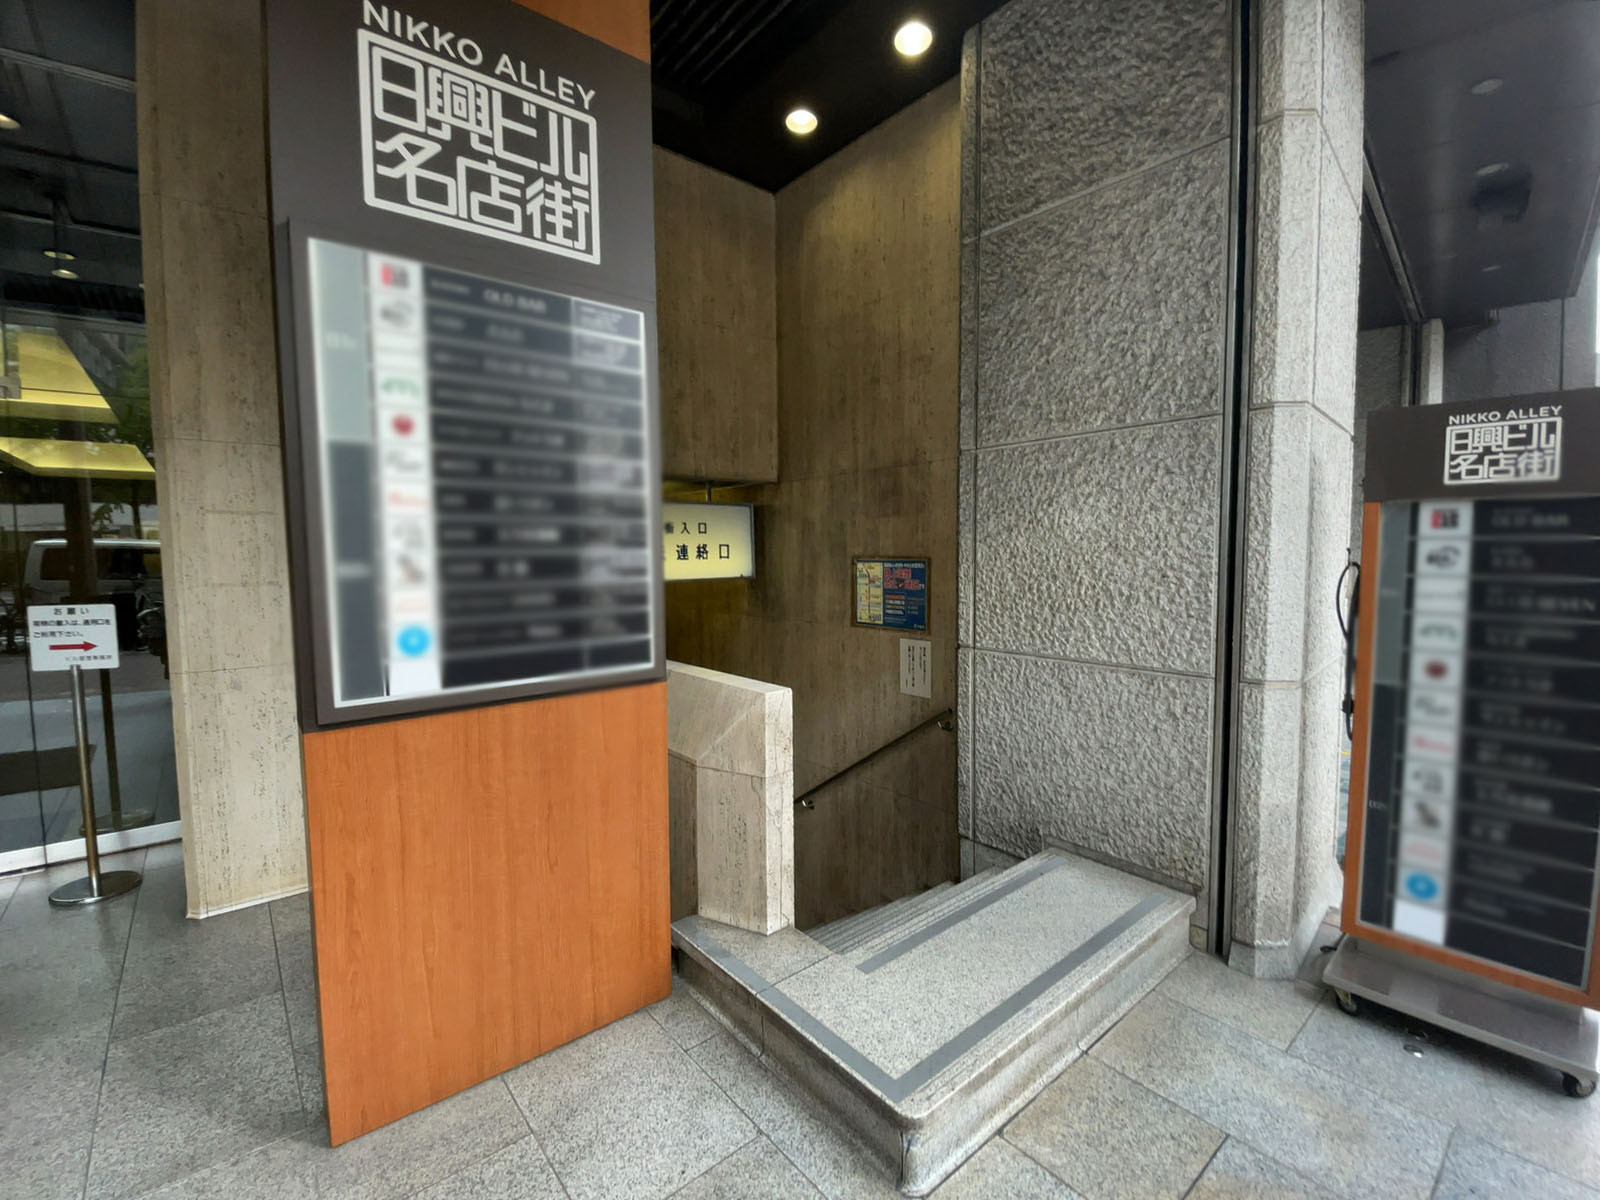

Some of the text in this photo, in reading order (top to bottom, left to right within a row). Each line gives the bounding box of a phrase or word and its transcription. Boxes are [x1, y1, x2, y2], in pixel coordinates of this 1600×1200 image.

[363, 0, 596, 110] NIKKO ALLEY
[372, 46, 589, 186] 日興ビル
[375, 132, 590, 250] 名店街
[1449, 405, 1562, 425] NIKKO ALLEY
[1451, 423, 1556, 455] 日興ビル
[1449, 451, 1555, 479] 名店街
